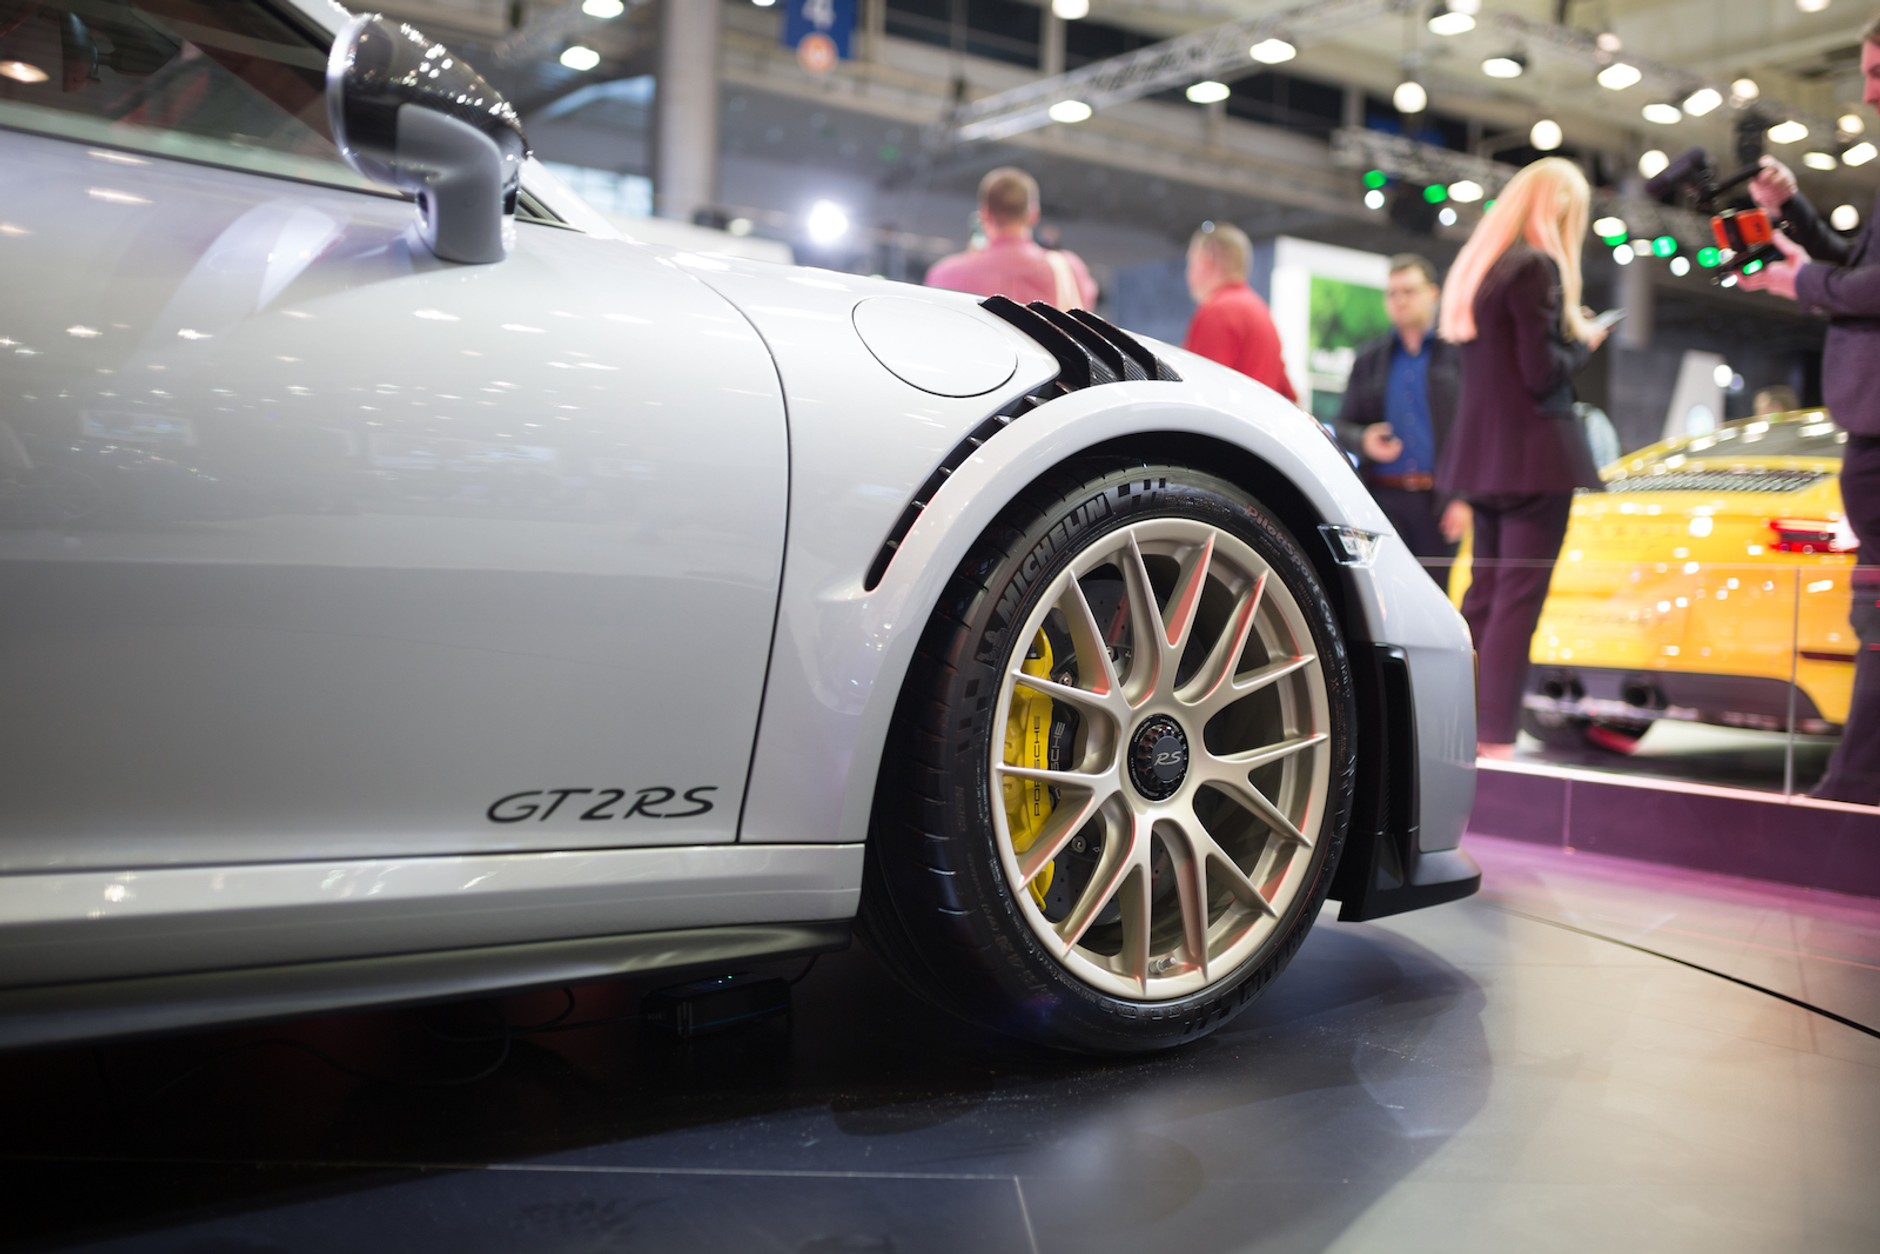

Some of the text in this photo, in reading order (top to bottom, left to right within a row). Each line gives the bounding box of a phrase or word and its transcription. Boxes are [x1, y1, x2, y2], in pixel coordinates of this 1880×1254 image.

[996, 494, 1107, 626] MICHELIN
[1283, 540, 1321, 594] Sport
[1319, 597, 1338, 638] Cup
[1154, 751, 1182, 766] RS
